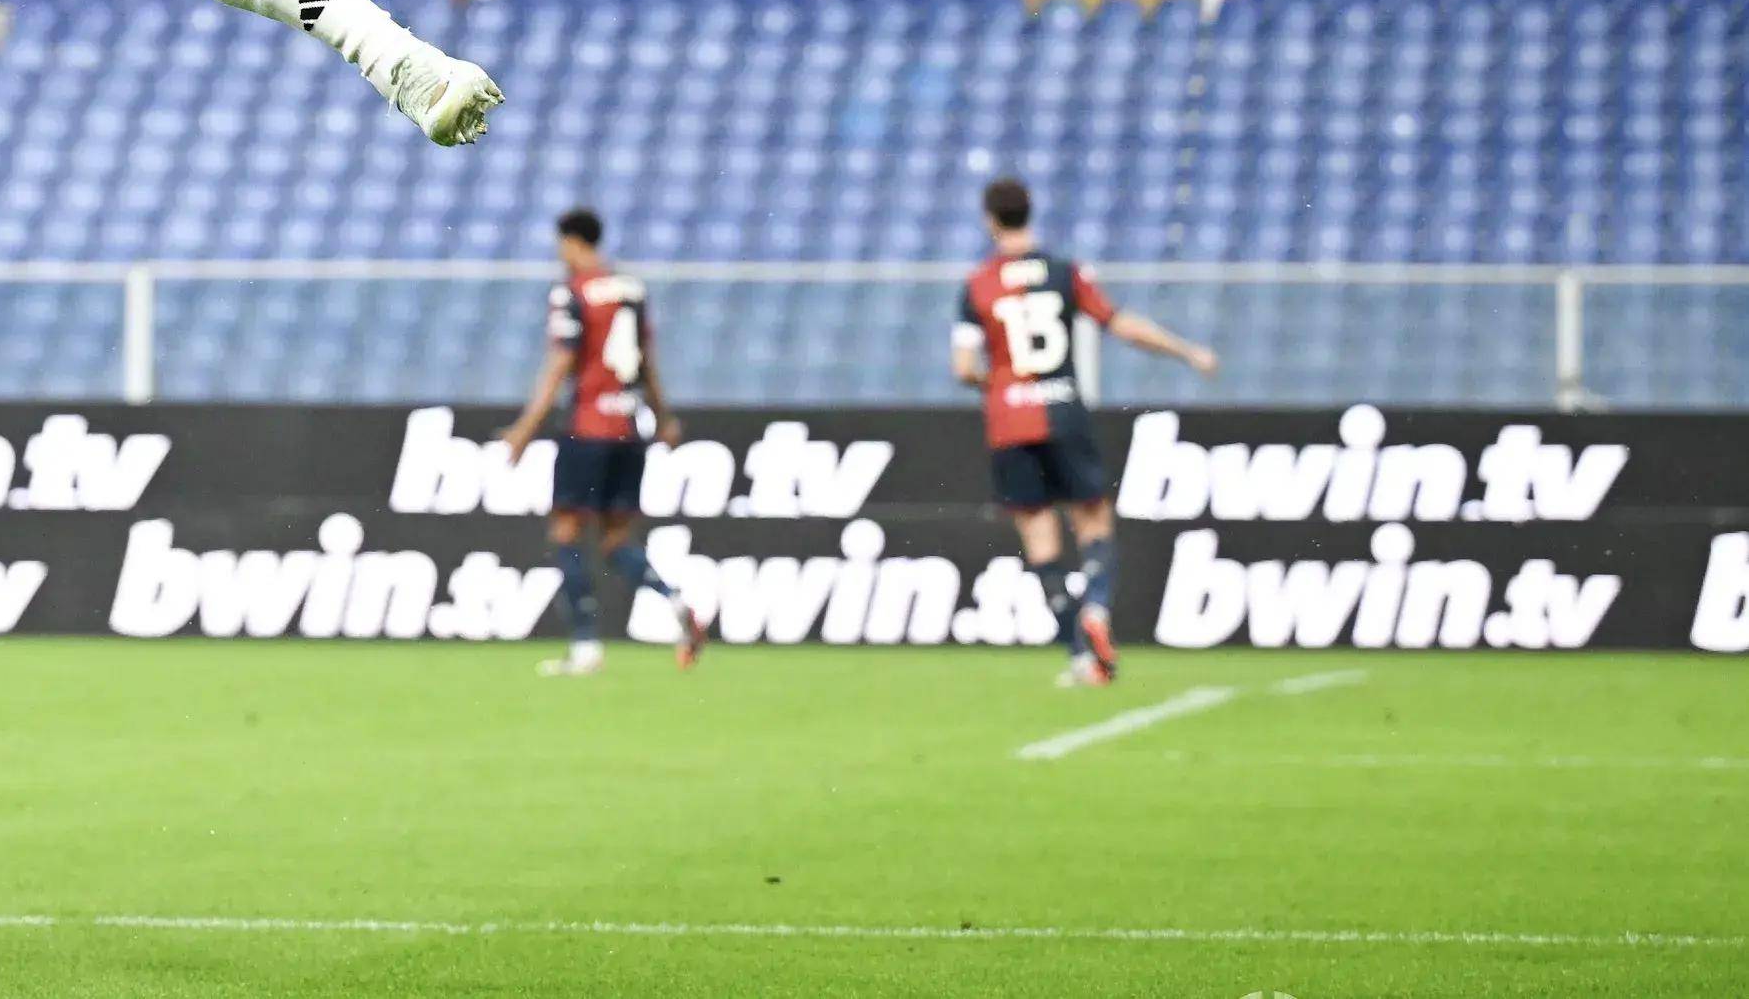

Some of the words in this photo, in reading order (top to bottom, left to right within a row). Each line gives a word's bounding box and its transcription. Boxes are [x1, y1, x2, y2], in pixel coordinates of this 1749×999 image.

[602, 305, 643, 385] 4
[1116, 403, 1630, 523] bwin.tv
[108, 512, 563, 639] bwin.tv
[1154, 522, 1622, 649] bwin.tv
